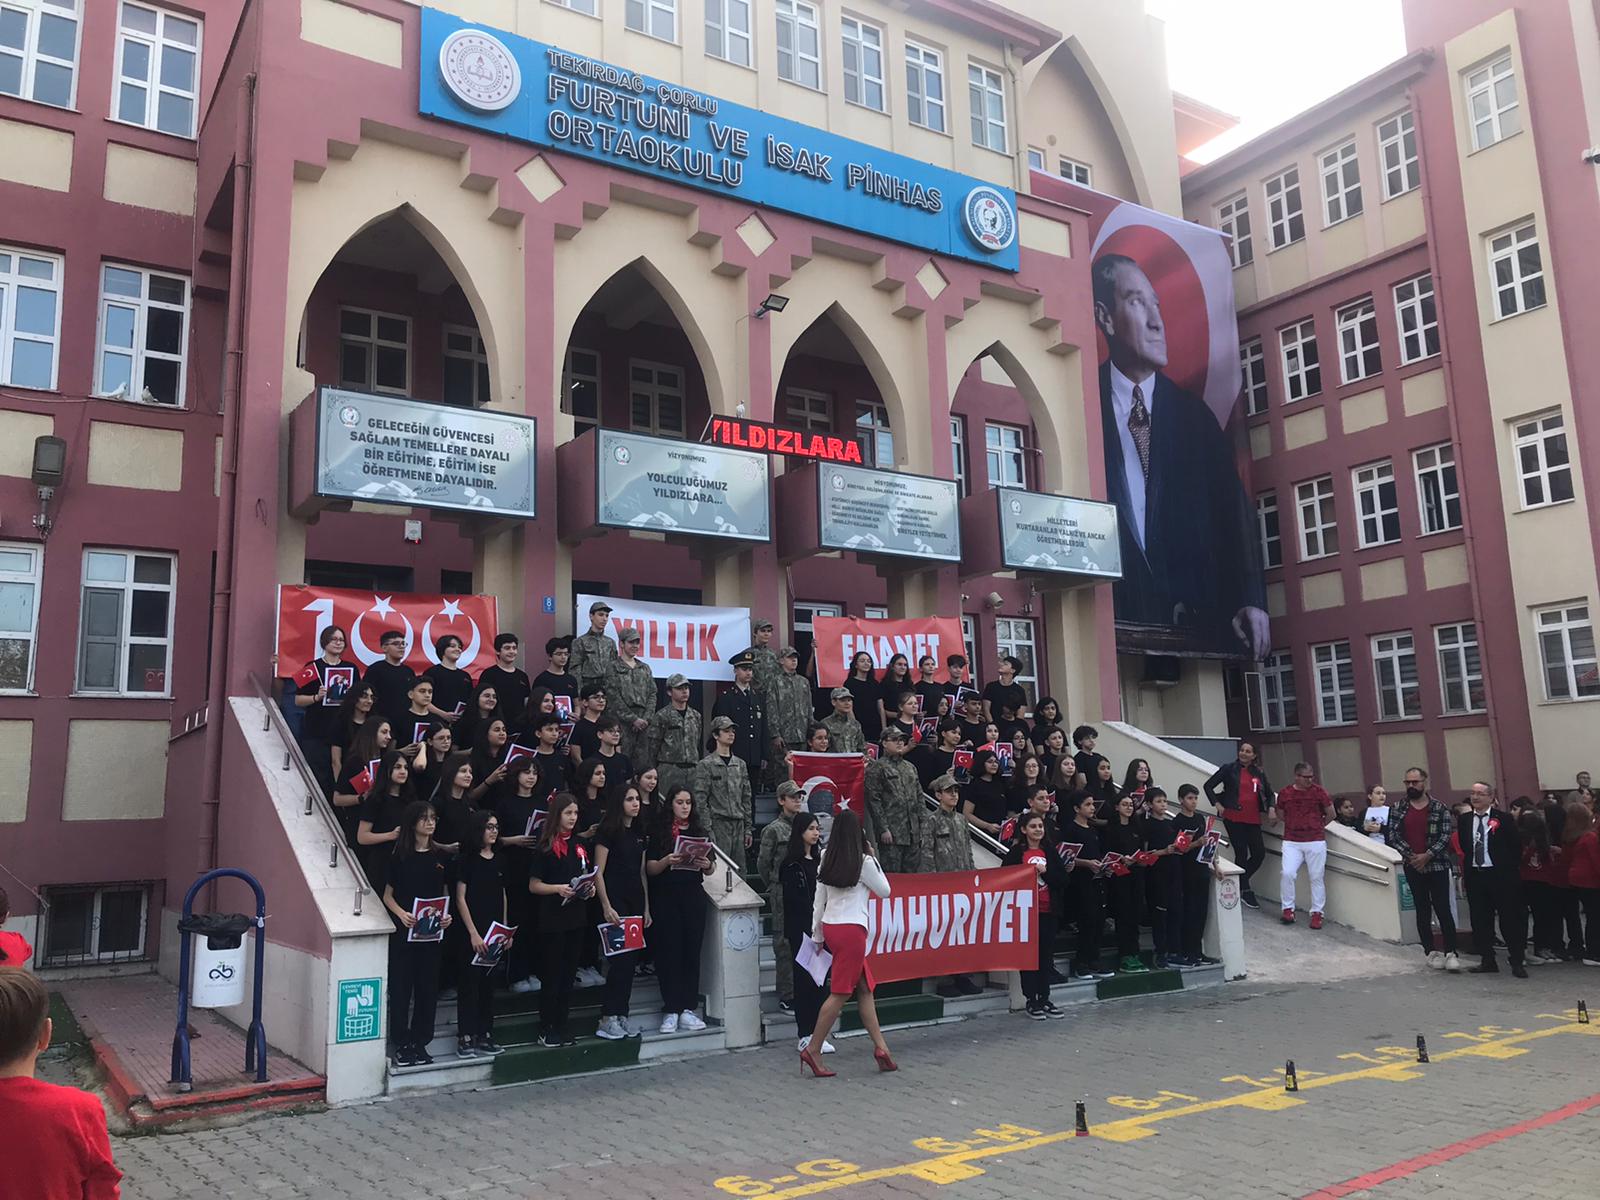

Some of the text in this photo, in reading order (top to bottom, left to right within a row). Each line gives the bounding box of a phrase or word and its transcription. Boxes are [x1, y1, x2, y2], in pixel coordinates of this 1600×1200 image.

[548, 73, 944, 212] FURTUNİ VE İSAK PİNHAS
[548, 109, 743, 187] ORTAOKULU
[350, 430, 510, 462] SAĞLAM TEMELLERE DAYALI
[368, 417, 494, 445] GELECEĞİN GÜVENCESİ
[362, 461, 497, 490] ÖĞRETMENE DAYALIDIR.
[364, 446, 384, 461] BİR
[438, 456, 476, 473] EĞİTİM
[479, 461, 497, 475] İSE
[647, 471, 728, 492] YOLCULUĞUMUZ
[653, 487, 723, 506] YILDIZLARA...
[610, 617, 721, 662] YILLIK
[911, 1123, 1043, 1153] 6-H
[713, 1158, 860, 1196] 6-G
